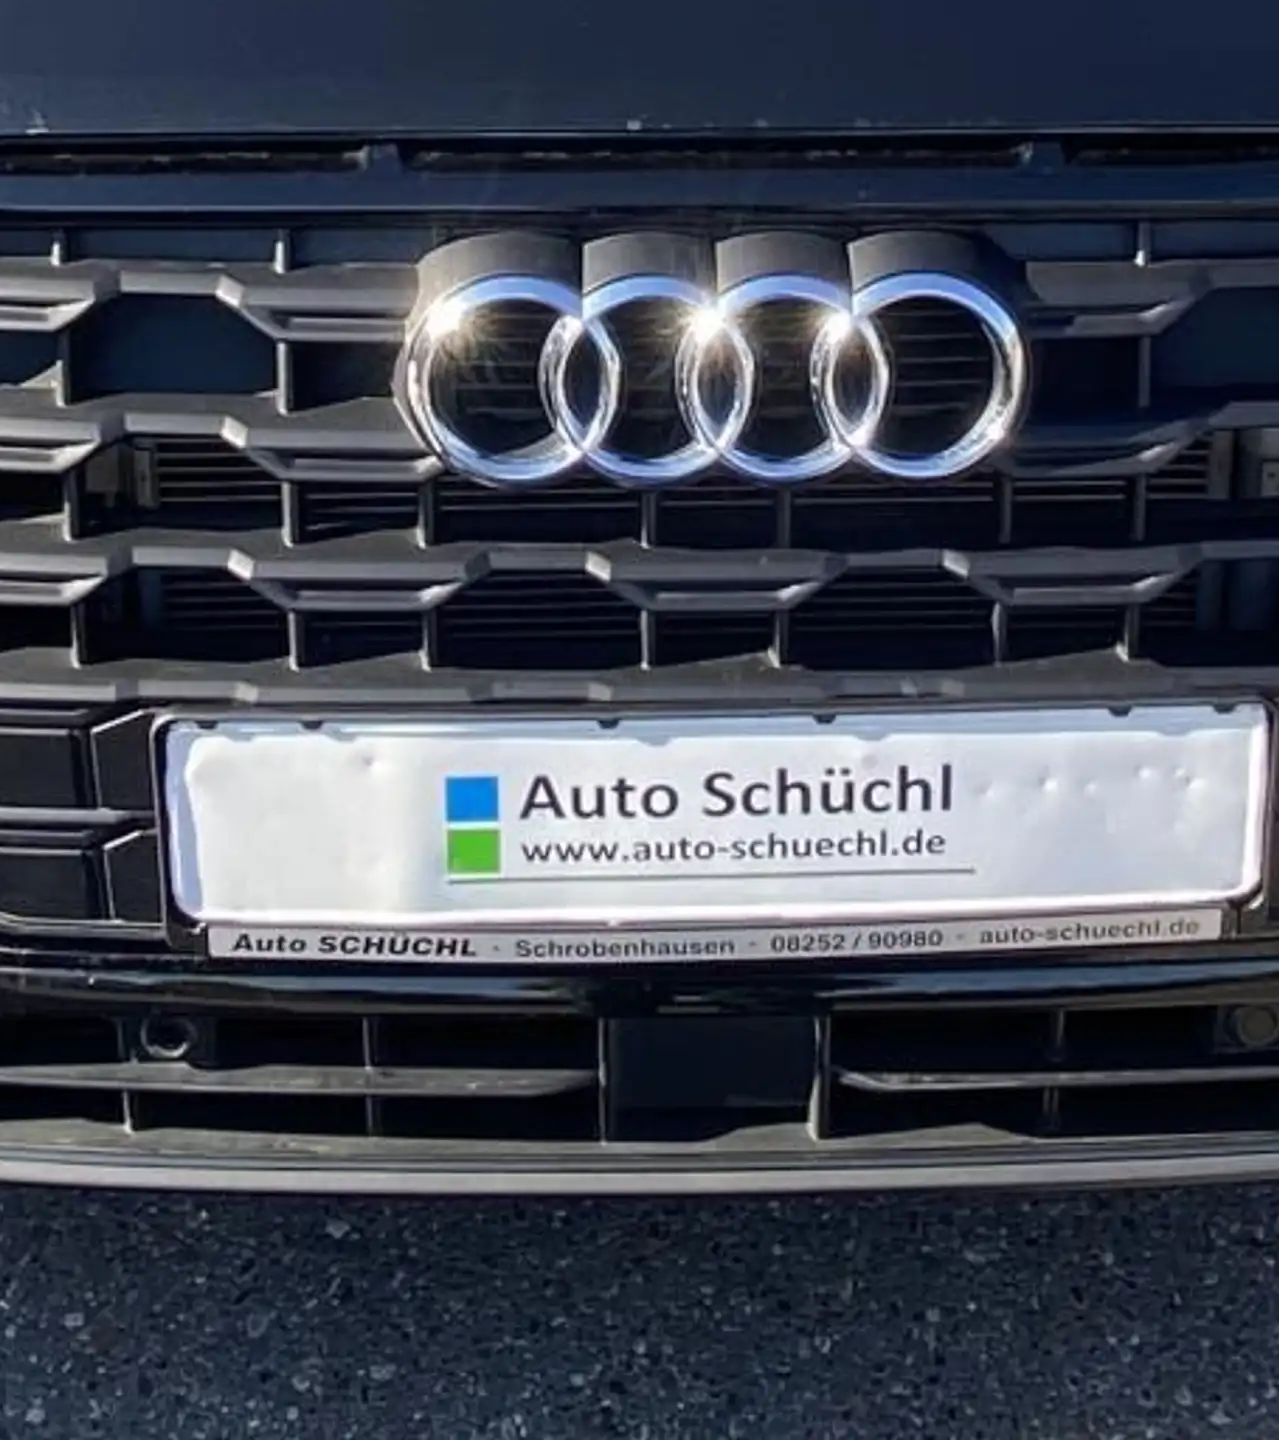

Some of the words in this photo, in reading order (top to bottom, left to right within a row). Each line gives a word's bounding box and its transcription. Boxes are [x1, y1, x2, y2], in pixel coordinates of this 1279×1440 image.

[520, 774, 679, 819] Auto
[702, 764, 952, 817] Schüchl
[522, 827, 946, 862] www.auto-schuechl.de
[232, 933, 307, 953] Auto
[318, 931, 477, 957] SCHÜCHL
[515, 938, 735, 958] Schrobenhausen
[770, 933, 845, 953] 08252
[868, 929, 943, 950] 90980
[979, 917, 1201, 945] auto-schuechl.de
